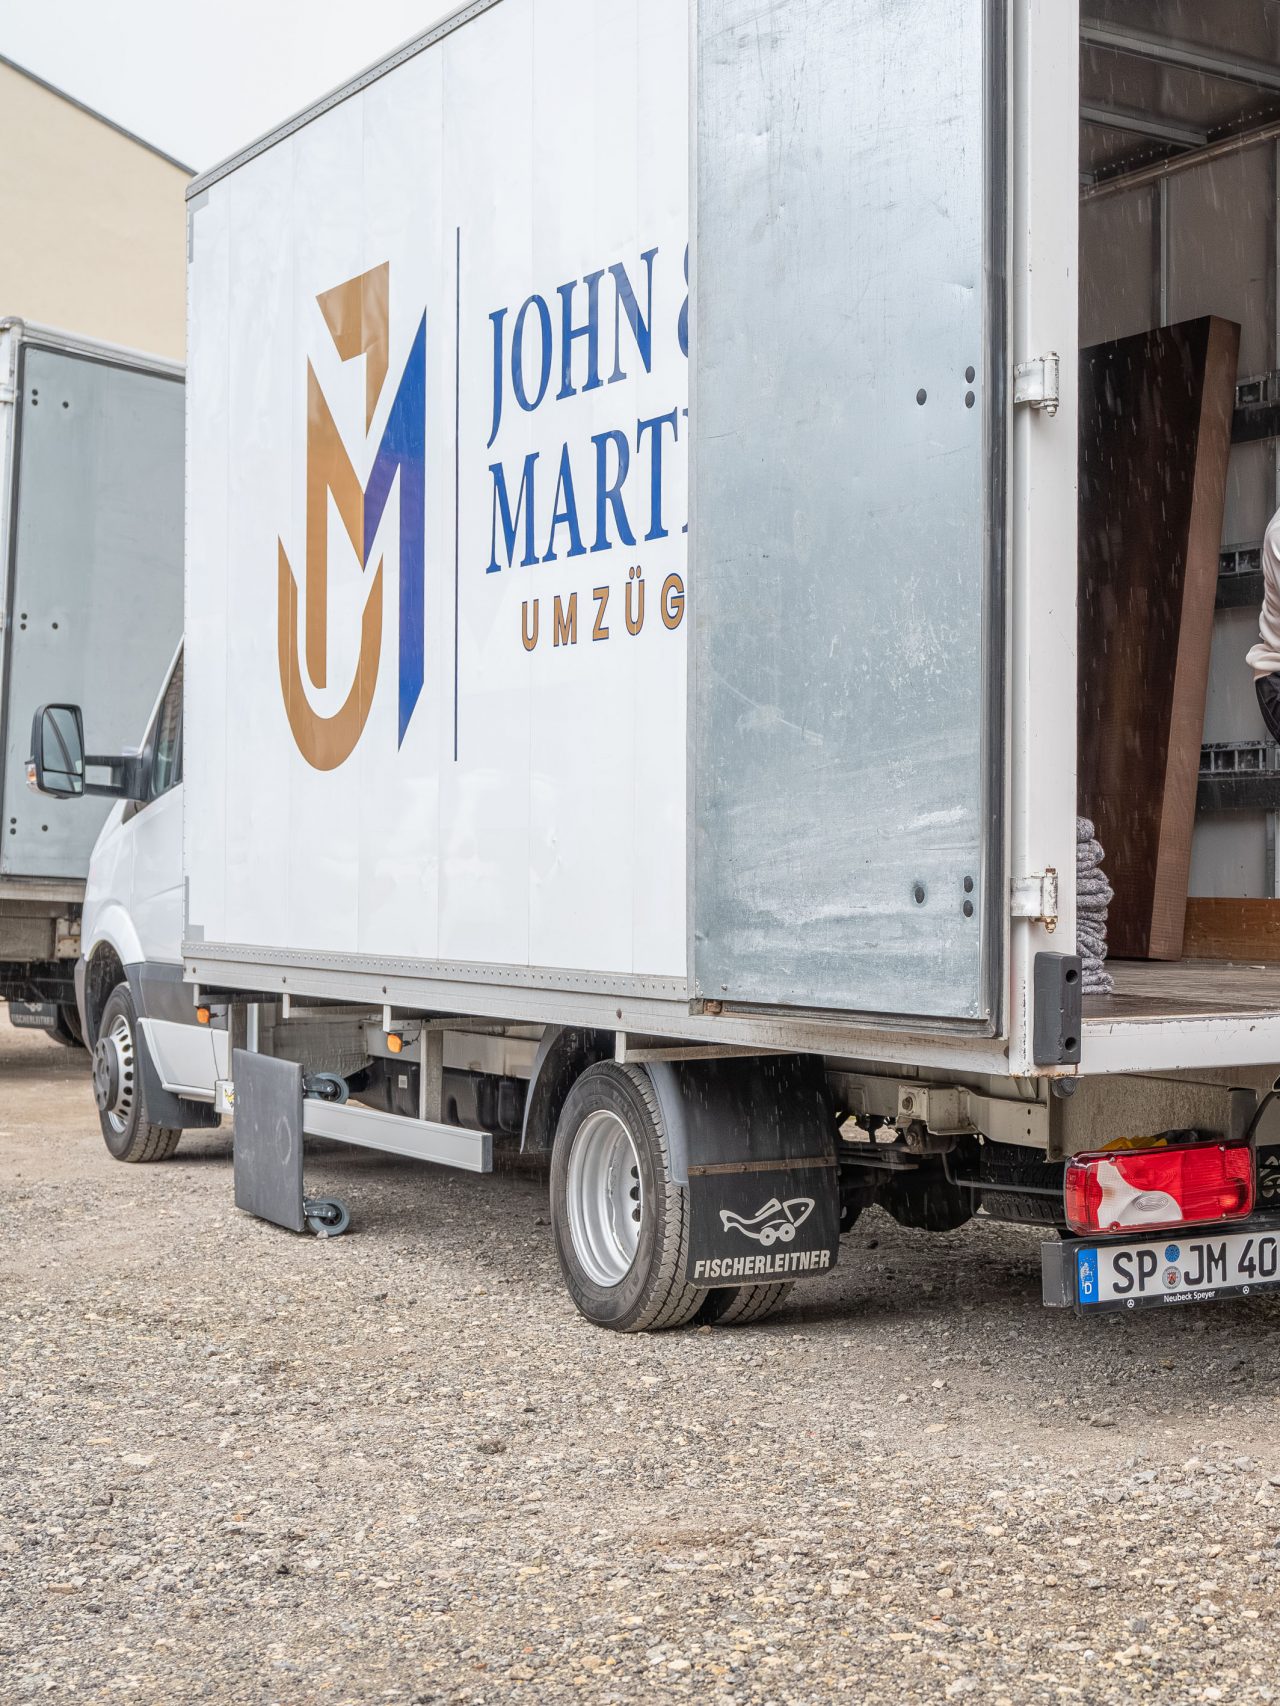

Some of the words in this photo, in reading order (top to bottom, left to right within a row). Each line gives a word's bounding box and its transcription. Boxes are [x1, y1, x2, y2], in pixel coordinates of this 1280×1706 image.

[486, 247, 658, 449] JOHN
[486, 406, 688, 574] MART
[521, 565, 686, 652] UMZÜG
[694, 1250, 831, 1279] FISCHERLEITNER
[1113, 1249, 1158, 1294] SP
[1183, 1242, 1227, 1286] JM
[1237, 1237, 1278, 1279] 40
[1163, 1293, 1193, 1303] Neubeck
[1193, 1290, 1216, 1302] Speyer
